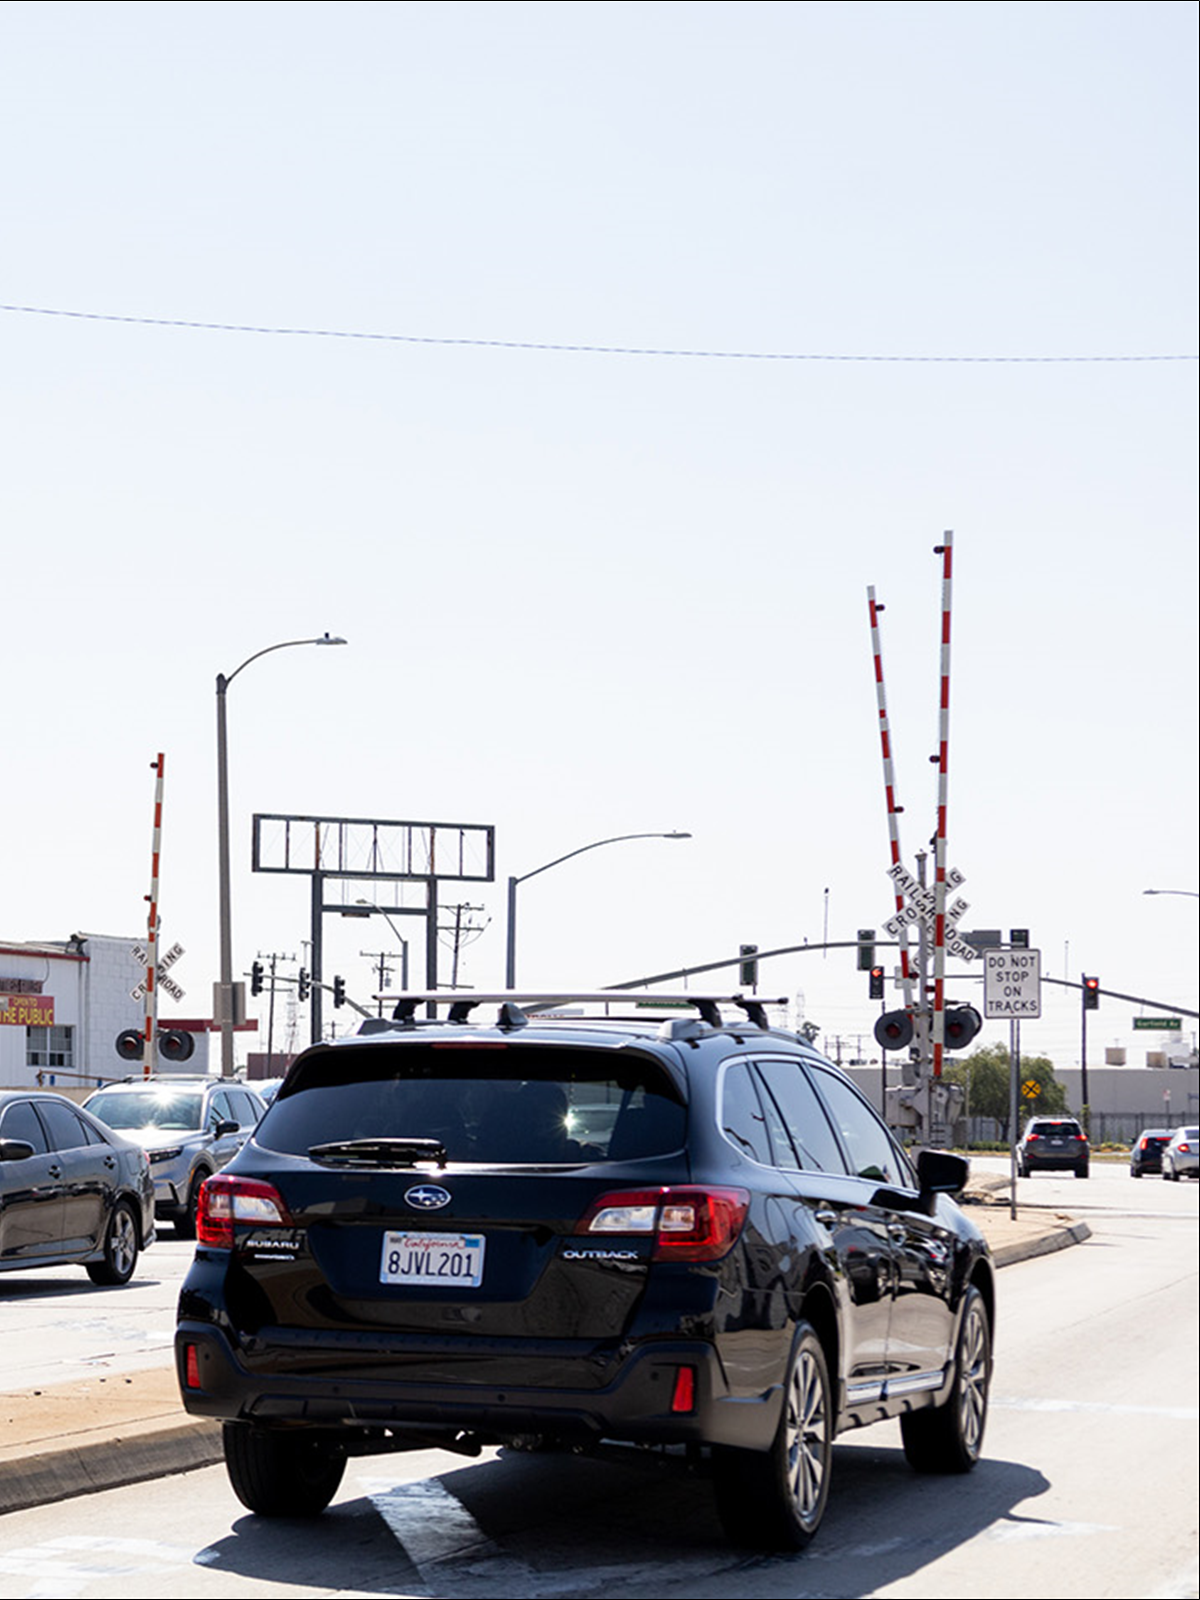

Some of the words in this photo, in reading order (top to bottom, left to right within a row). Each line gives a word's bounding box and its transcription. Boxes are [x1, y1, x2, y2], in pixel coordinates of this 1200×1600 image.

[989, 956, 1005, 968] DO
[1011, 956, 1035, 968] NOT
[131, 945, 184, 1000] RAIROAD
[996, 971, 1029, 982] STOP
[1003, 985, 1021, 997] ON
[988, 1000, 1037, 1012] TRACKS
[18, 1008, 53, 1025] PUBLIC
[246, 1239, 299, 1250] SUBARU
[404, 1237, 465, 1251] California
[563, 1249, 639, 1260] OUTBACK
[388, 1250, 474, 1278] 8JVL201
